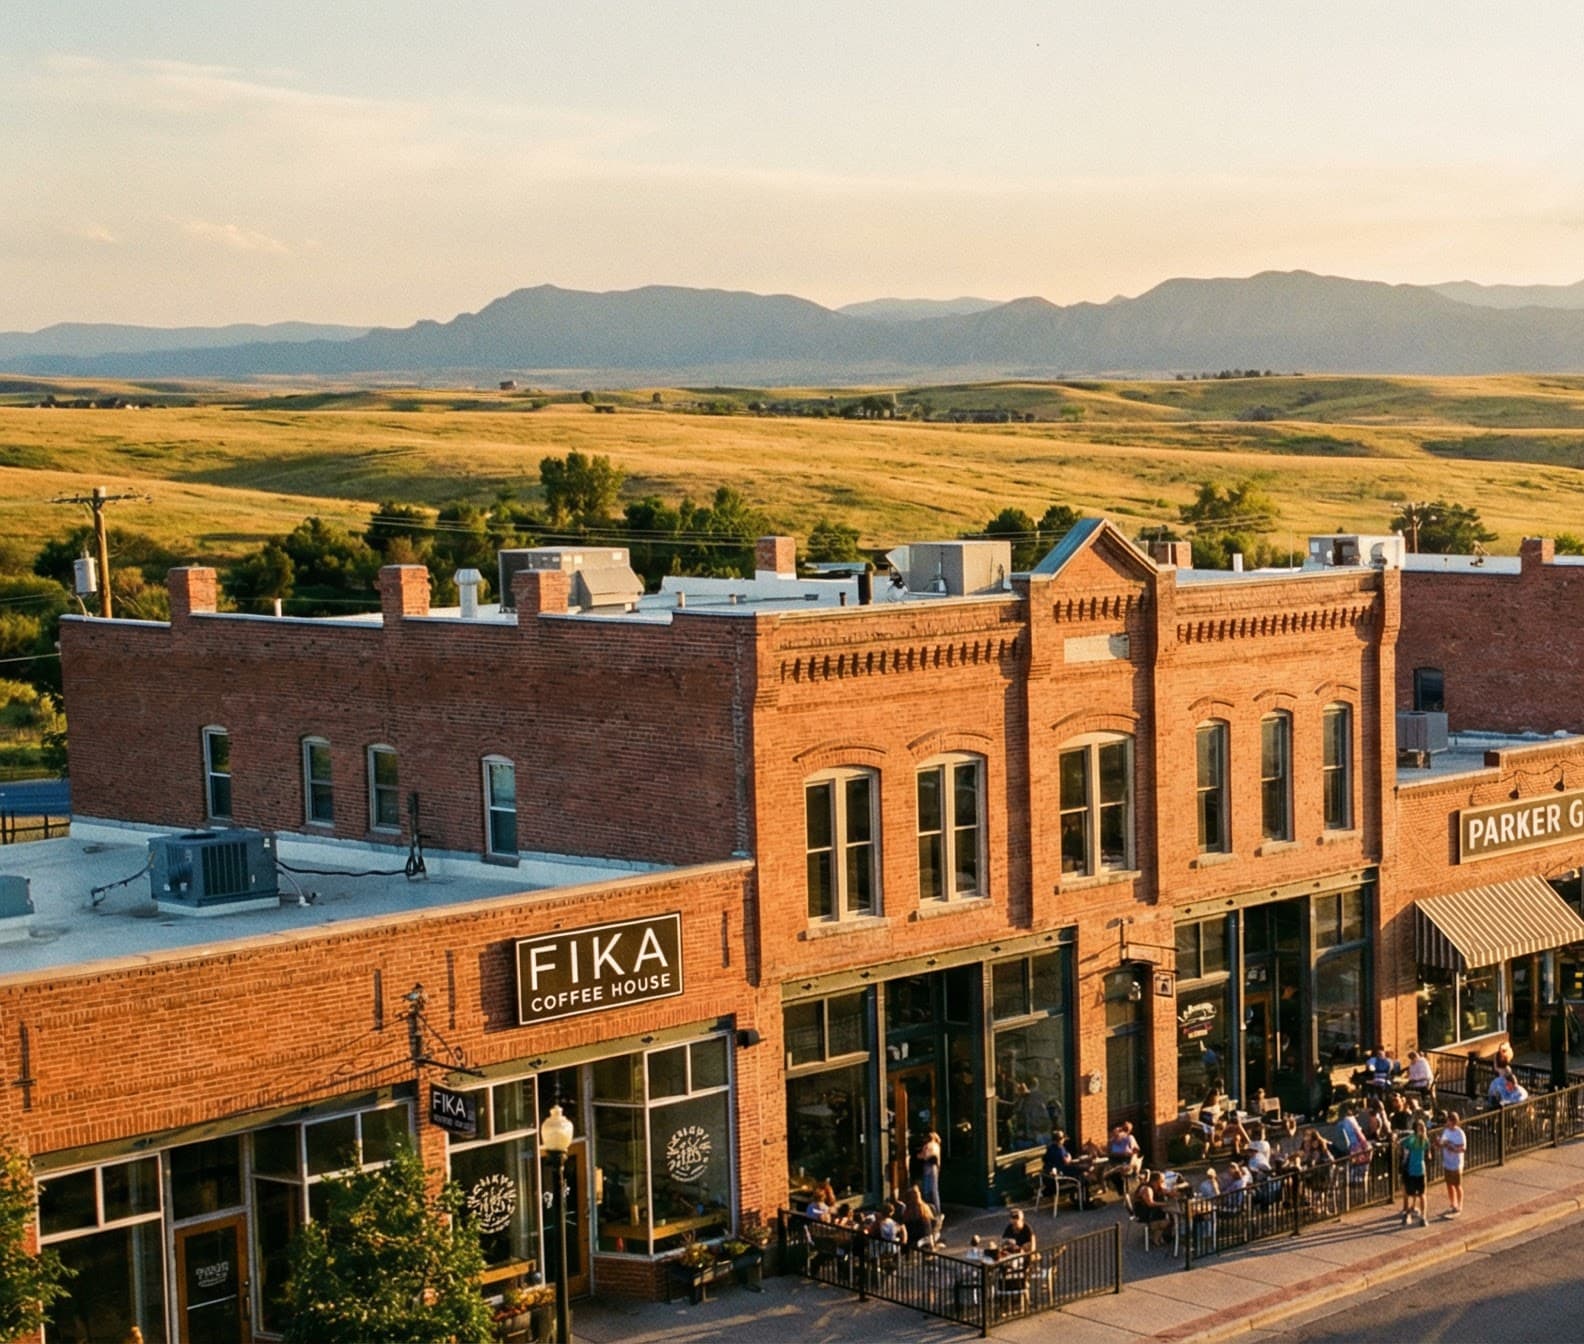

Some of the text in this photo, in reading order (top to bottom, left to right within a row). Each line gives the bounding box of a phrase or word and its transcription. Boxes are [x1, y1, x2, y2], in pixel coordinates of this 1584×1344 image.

[1468, 804, 1561, 849] PARKER
[530, 927, 669, 991] FIKA
[531, 973, 671, 1012] COFFEE HOUSE
[433, 1090, 466, 1118] FIKA
